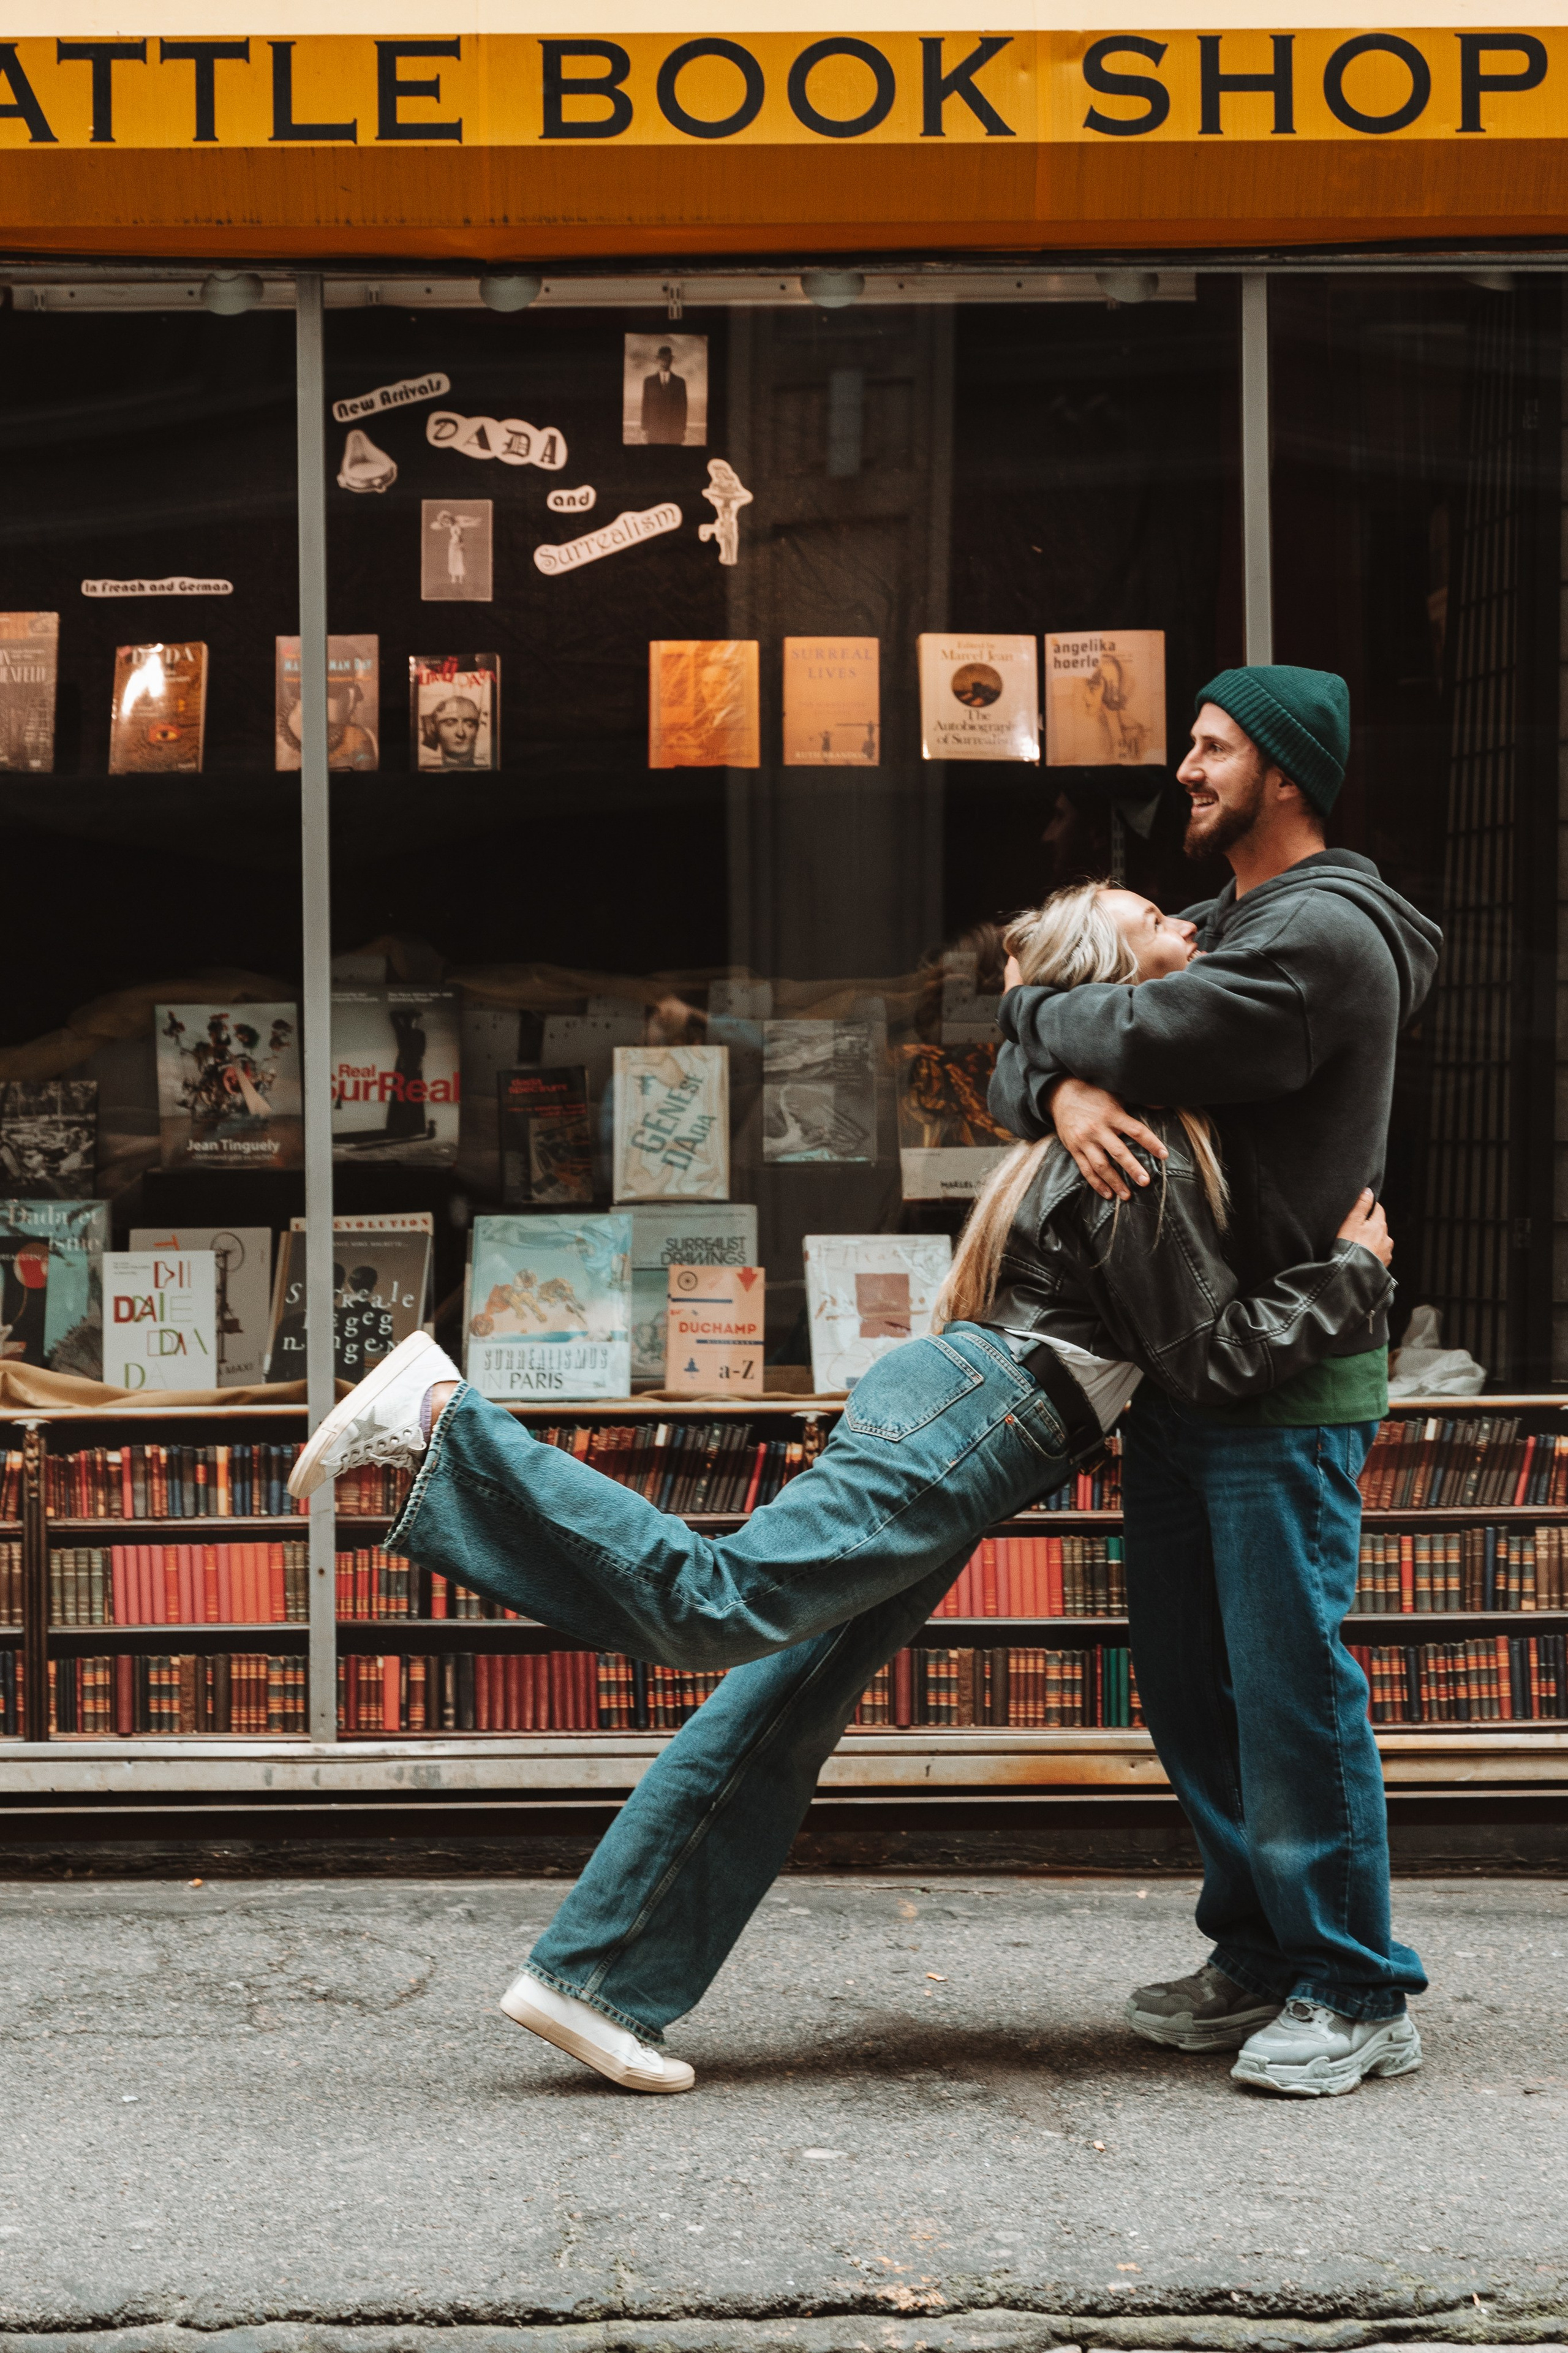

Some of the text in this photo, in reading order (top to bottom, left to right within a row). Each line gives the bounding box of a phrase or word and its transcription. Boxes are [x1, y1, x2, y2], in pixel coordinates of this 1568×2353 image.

[537, 36, 1016, 140] BOOK
[1082, 32, 1548, 136] SHOP
[337, 379, 442, 419] New Arrivals
[432, 417, 559, 465] DADA
[552, 491, 590, 507] and
[539, 507, 677, 572] Surrealism
[102, 581, 145, 593] French
[149, 582, 175, 592] and
[178, 581, 230, 592] German
[791, 648, 873, 660] SURREAL
[1053, 638, 1117, 655] angelika
[941, 649, 1014, 661] Marcel Jean
[1053, 655, 1099, 669] hoerle
[808, 667, 857, 679] LIVES
[965, 709, 991, 720] The
[937, 733, 949, 744] of
[337, 1063, 377, 1078] Real
[186, 1138, 281, 1155] Jean Tinguely
[678, 1321, 757, 1335] DUCHAMP
[718, 1359, 755, 1380] a-Z
[509, 1372, 564, 1390] PARIS
